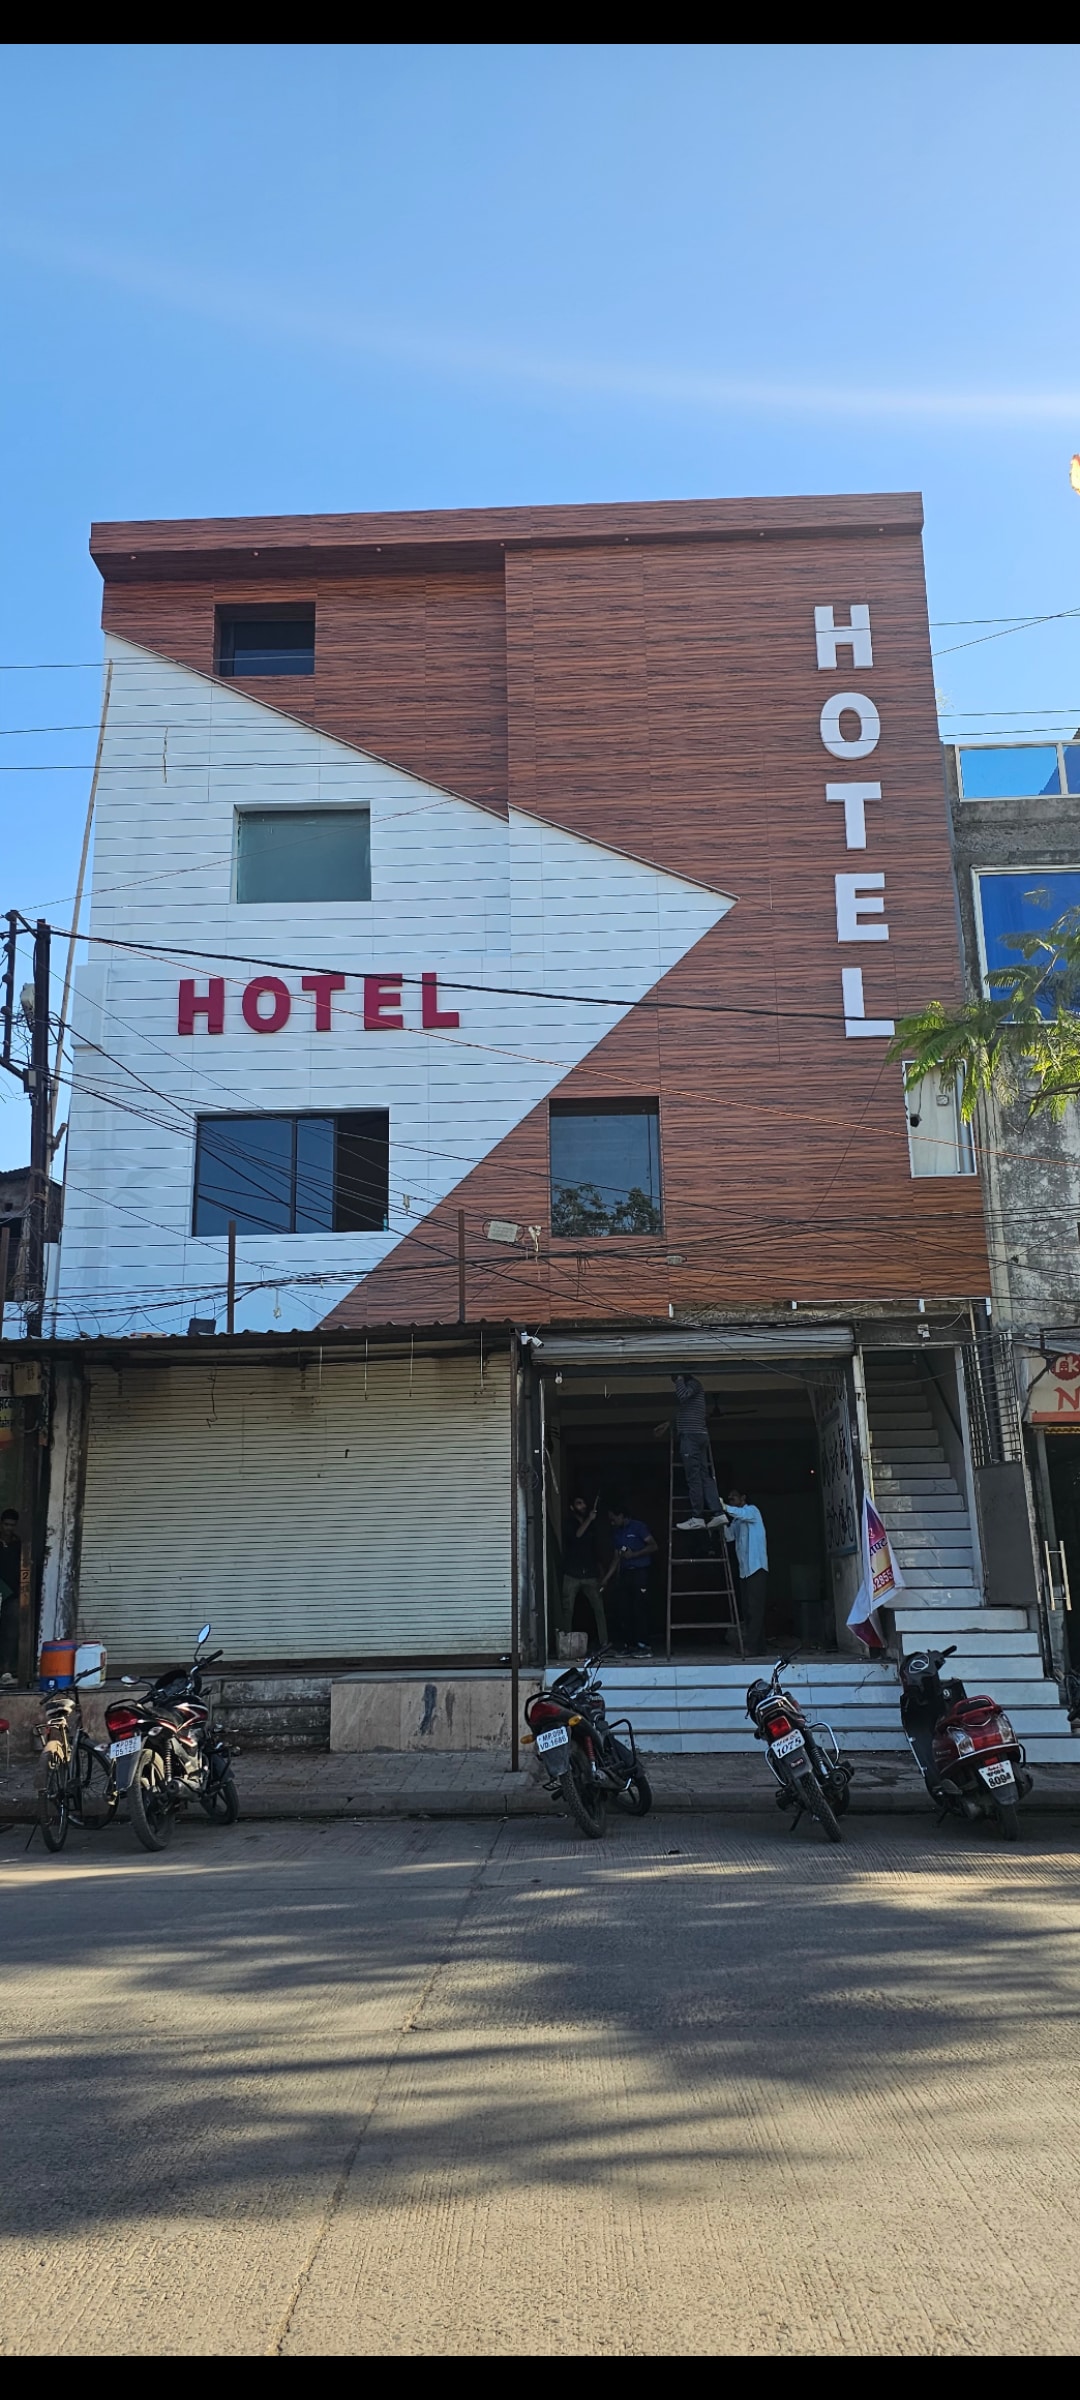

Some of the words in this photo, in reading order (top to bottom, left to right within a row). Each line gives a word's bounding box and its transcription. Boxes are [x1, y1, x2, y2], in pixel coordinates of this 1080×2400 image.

[814, 604, 895, 1038] HOTEL
[178, 972, 460, 1035] HOTEL
[777, 1737, 801, 1757] 1075
